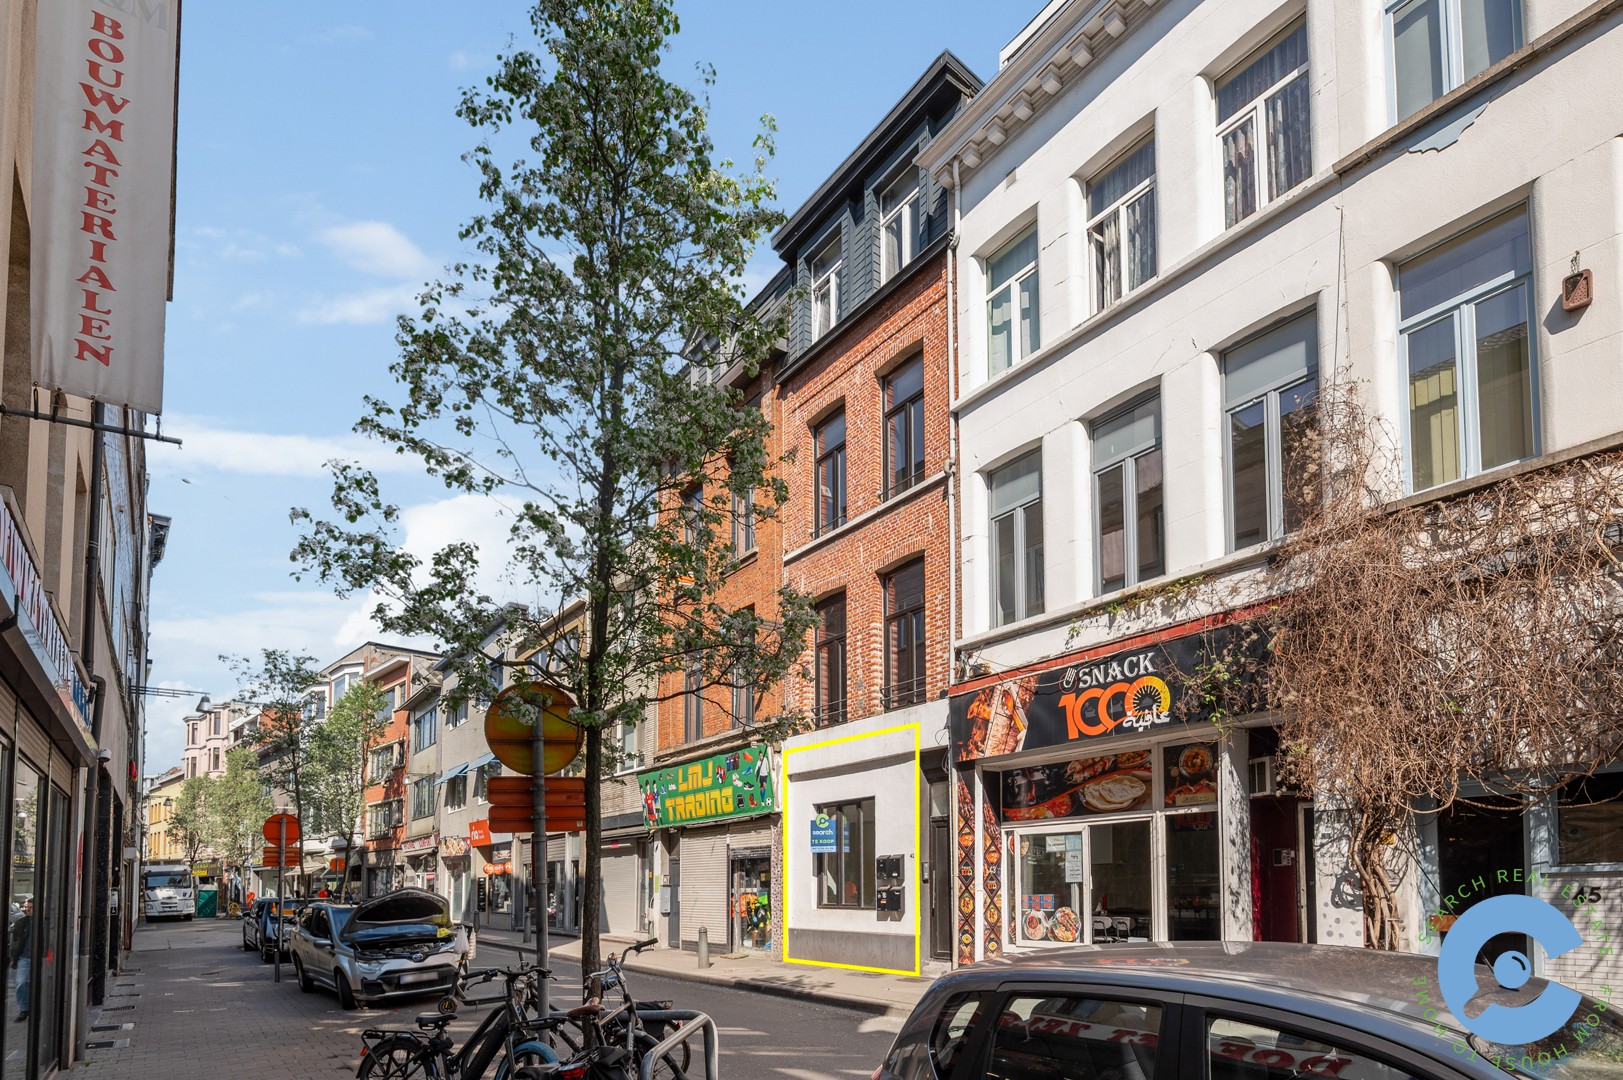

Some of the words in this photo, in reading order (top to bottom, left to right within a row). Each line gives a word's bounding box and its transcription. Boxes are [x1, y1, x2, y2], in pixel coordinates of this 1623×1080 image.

[74, 9, 130, 367] BOUWMATERIALEN
[1078, 651, 1157, 689] SNACK
[678, 760, 713, 793] LMJ
[665, 785, 734, 822] TRADING
